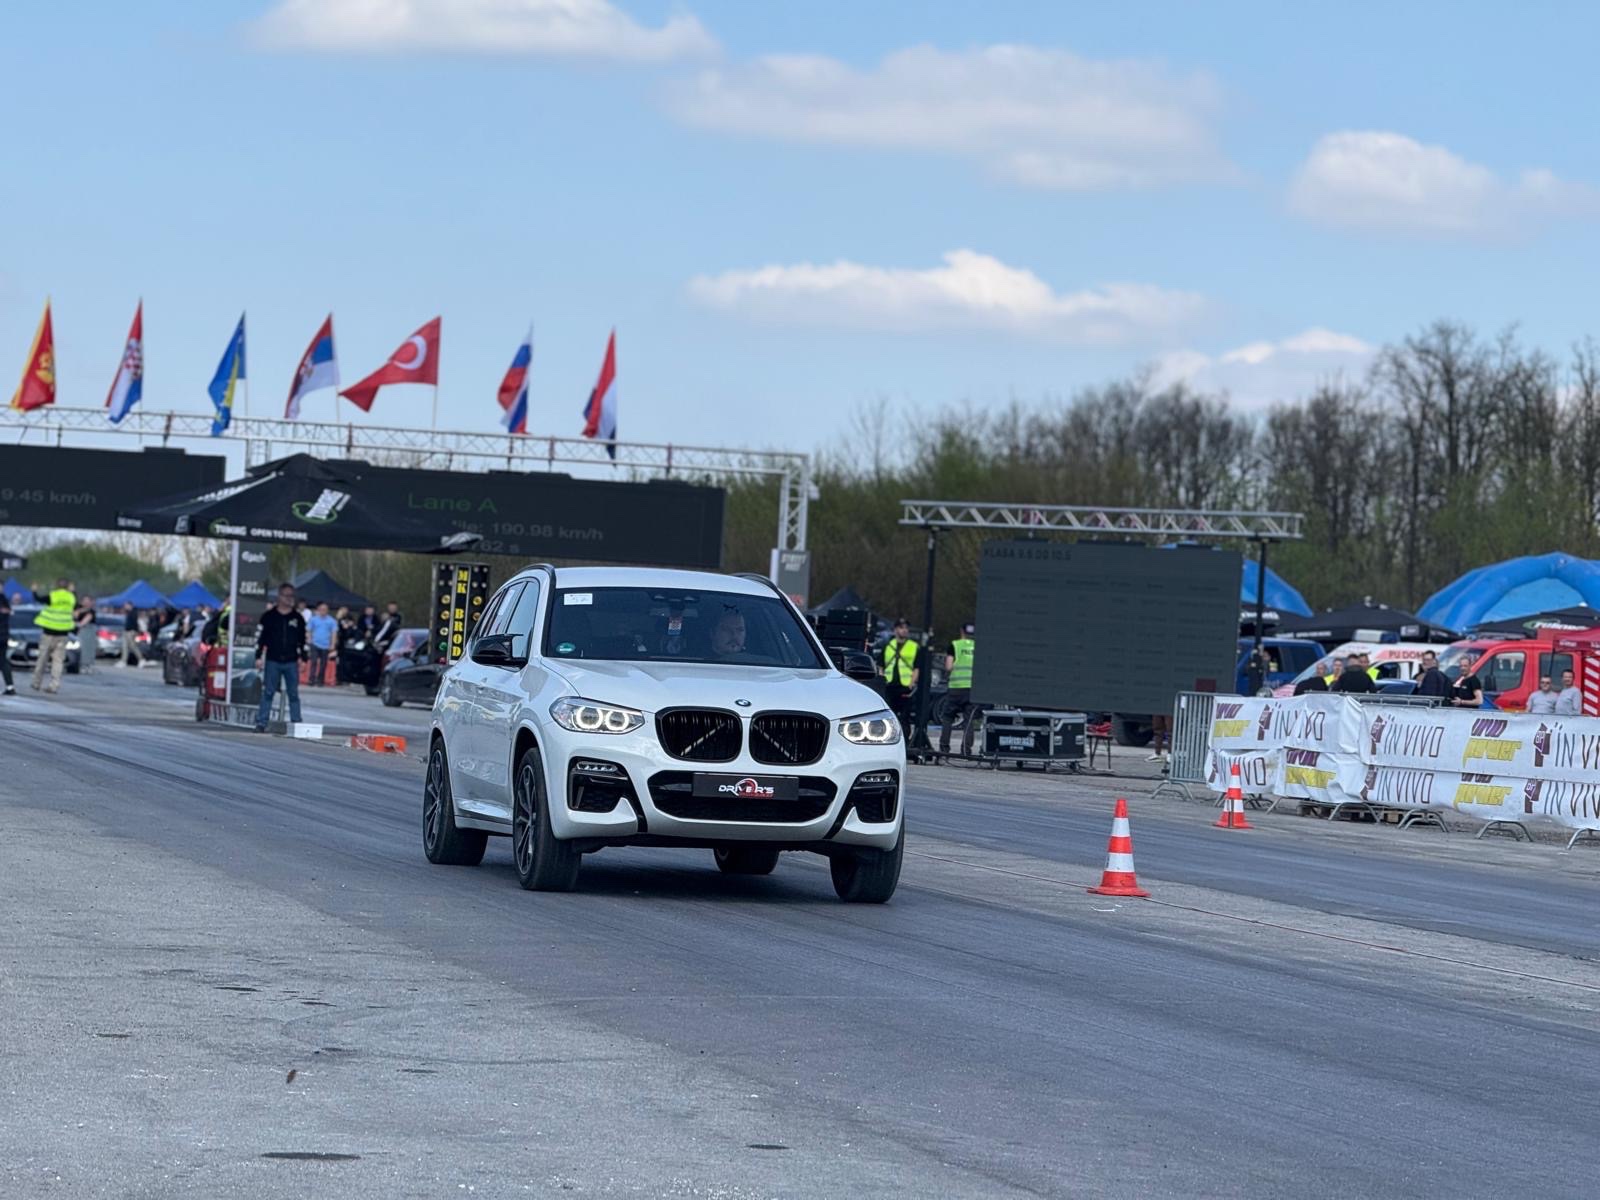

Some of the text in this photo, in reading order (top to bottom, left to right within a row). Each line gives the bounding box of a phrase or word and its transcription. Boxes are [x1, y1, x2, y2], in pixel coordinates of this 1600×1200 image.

[49, 489, 96, 505] km/h
[408, 492, 497, 513] Lane A
[250, 528, 272, 537] OPEN
[273, 530, 284, 539] TO
[285, 531, 308, 541] MORE
[493, 522, 553, 537] 190.98
[558, 527, 604, 541] km/h
[1403, 724, 1445, 758] VIVO
[718, 783, 775, 796] DRIVER'S
[1376, 770, 1435, 804] IN VIVO
[1544, 780, 1566, 815] IN
